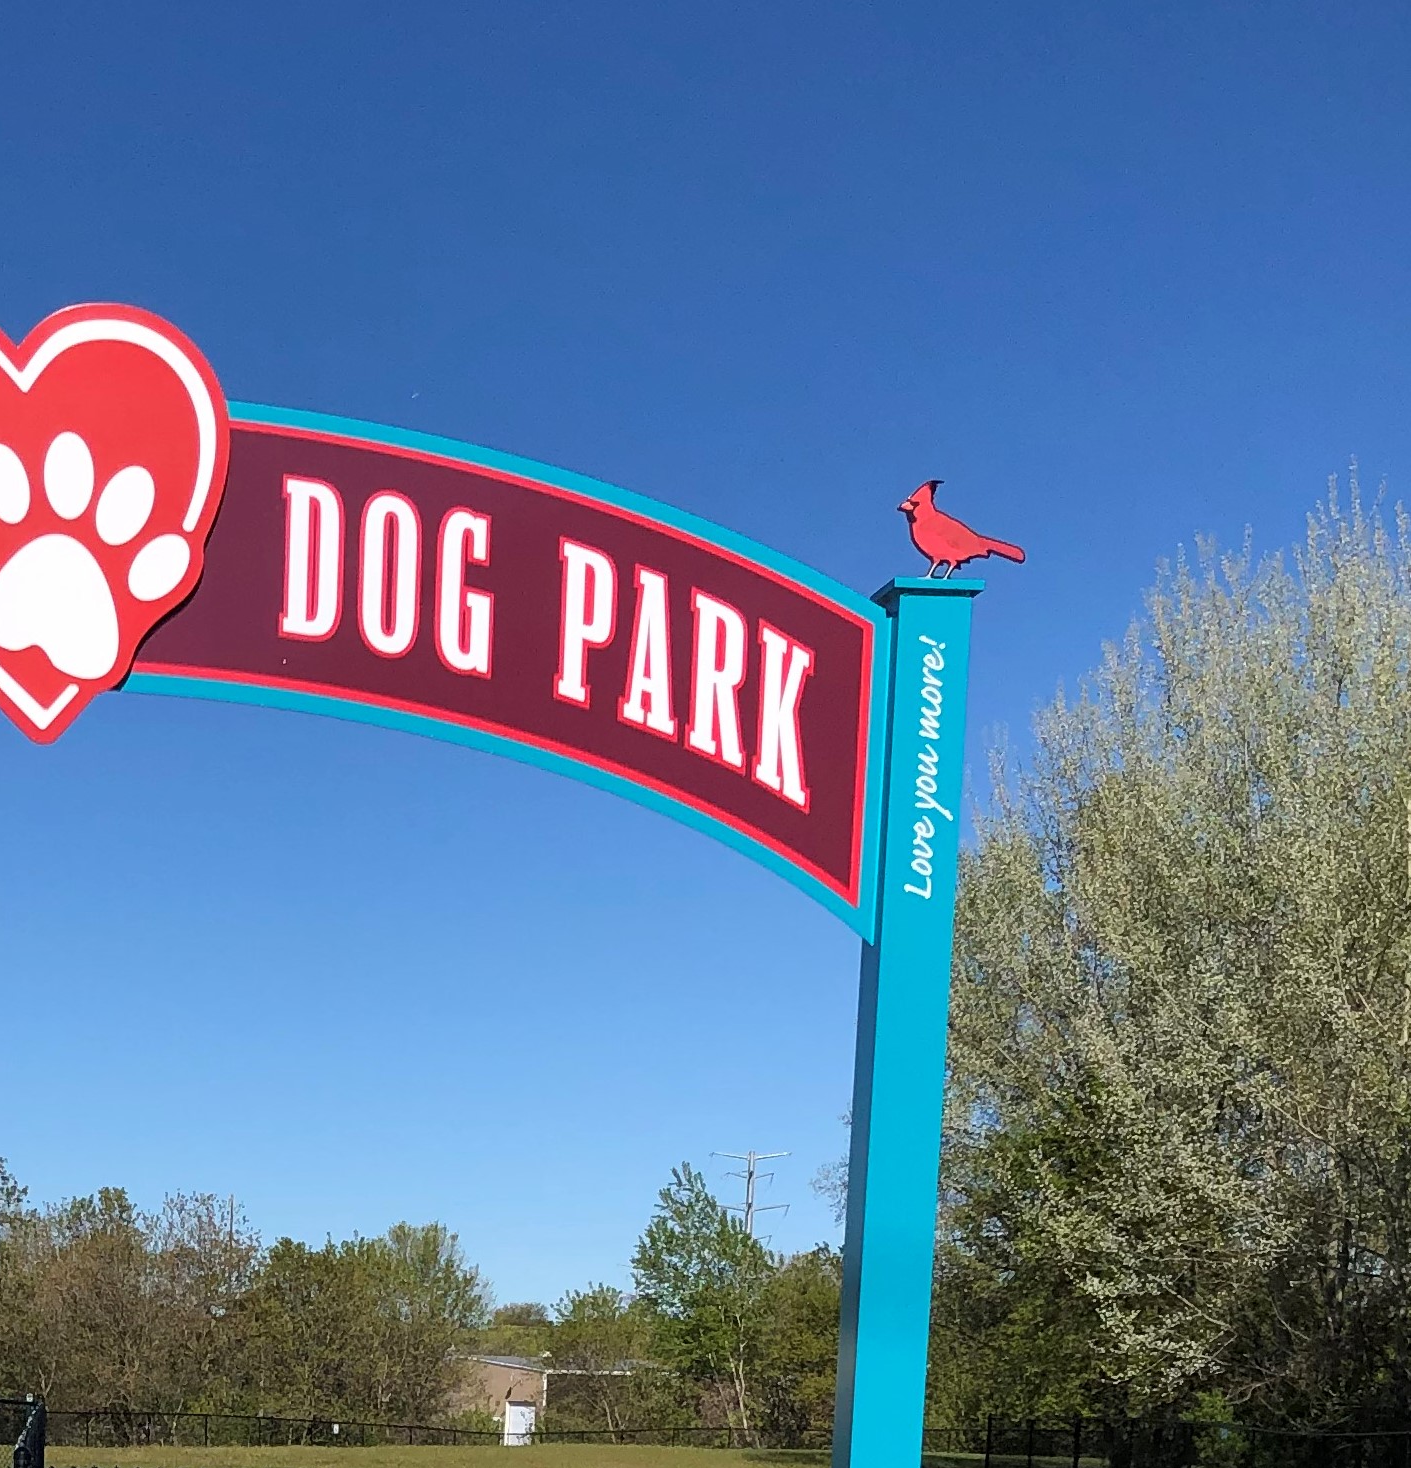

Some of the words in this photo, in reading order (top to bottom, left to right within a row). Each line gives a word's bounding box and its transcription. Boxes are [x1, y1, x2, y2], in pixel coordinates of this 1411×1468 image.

[279, 475, 494, 677] DOG
[555, 537, 814, 813] PARK
[919, 635, 946, 740] more!
[915, 744, 953, 821] you
[904, 816, 935, 899] Love
